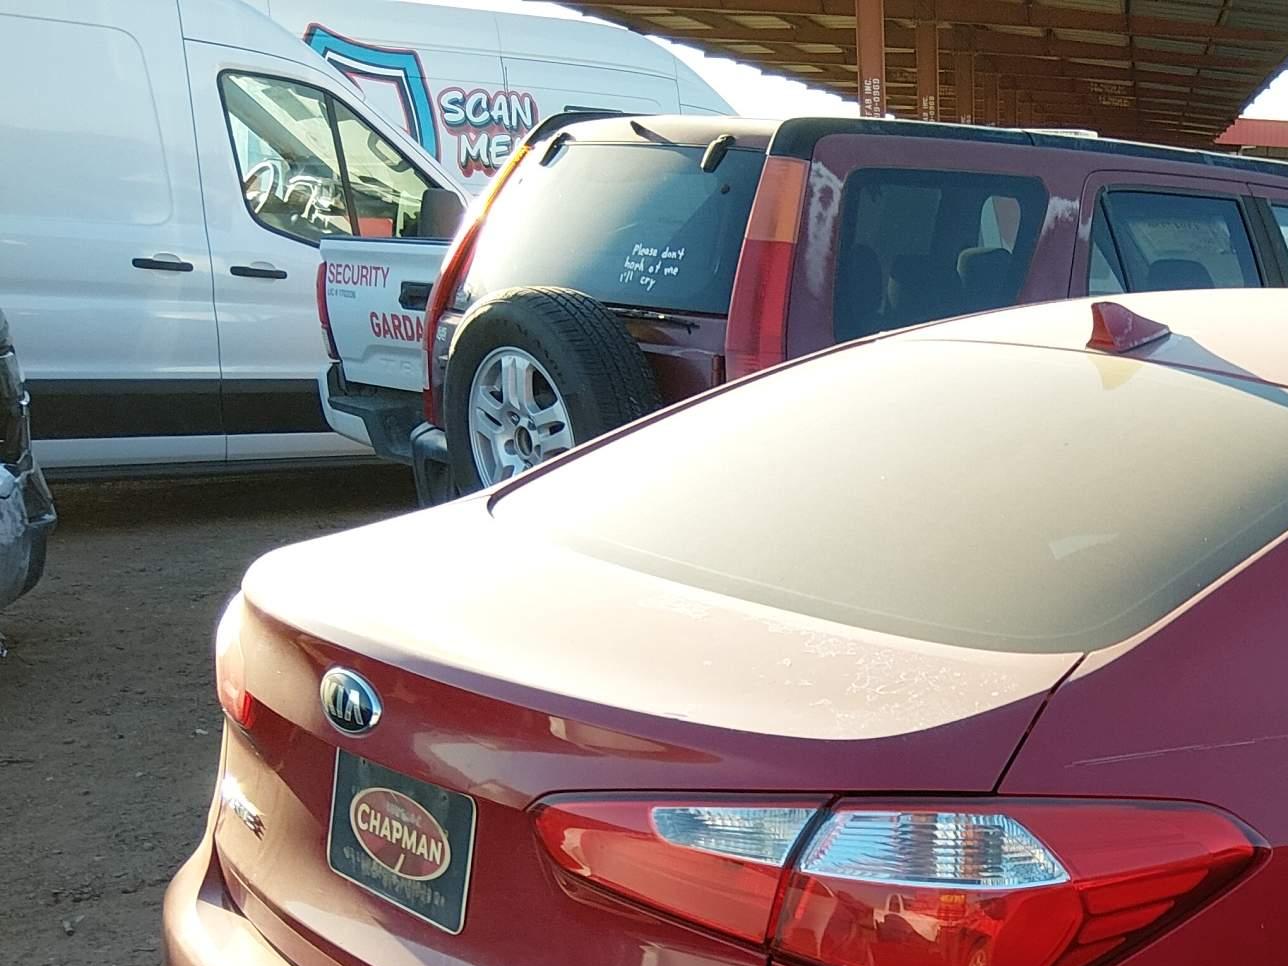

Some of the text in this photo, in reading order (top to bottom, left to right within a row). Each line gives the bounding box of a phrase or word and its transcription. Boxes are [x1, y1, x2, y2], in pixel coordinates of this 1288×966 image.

[440, 90, 533, 129] SCAN
[632, 243, 658, 257] Please
[328, 263, 390, 288] SECURITY
[640, 276, 656, 291] cry
[664, 266, 679, 276] me
[323, 678, 364, 725] KIA
[357, 803, 443, 865] CHAPMAN
